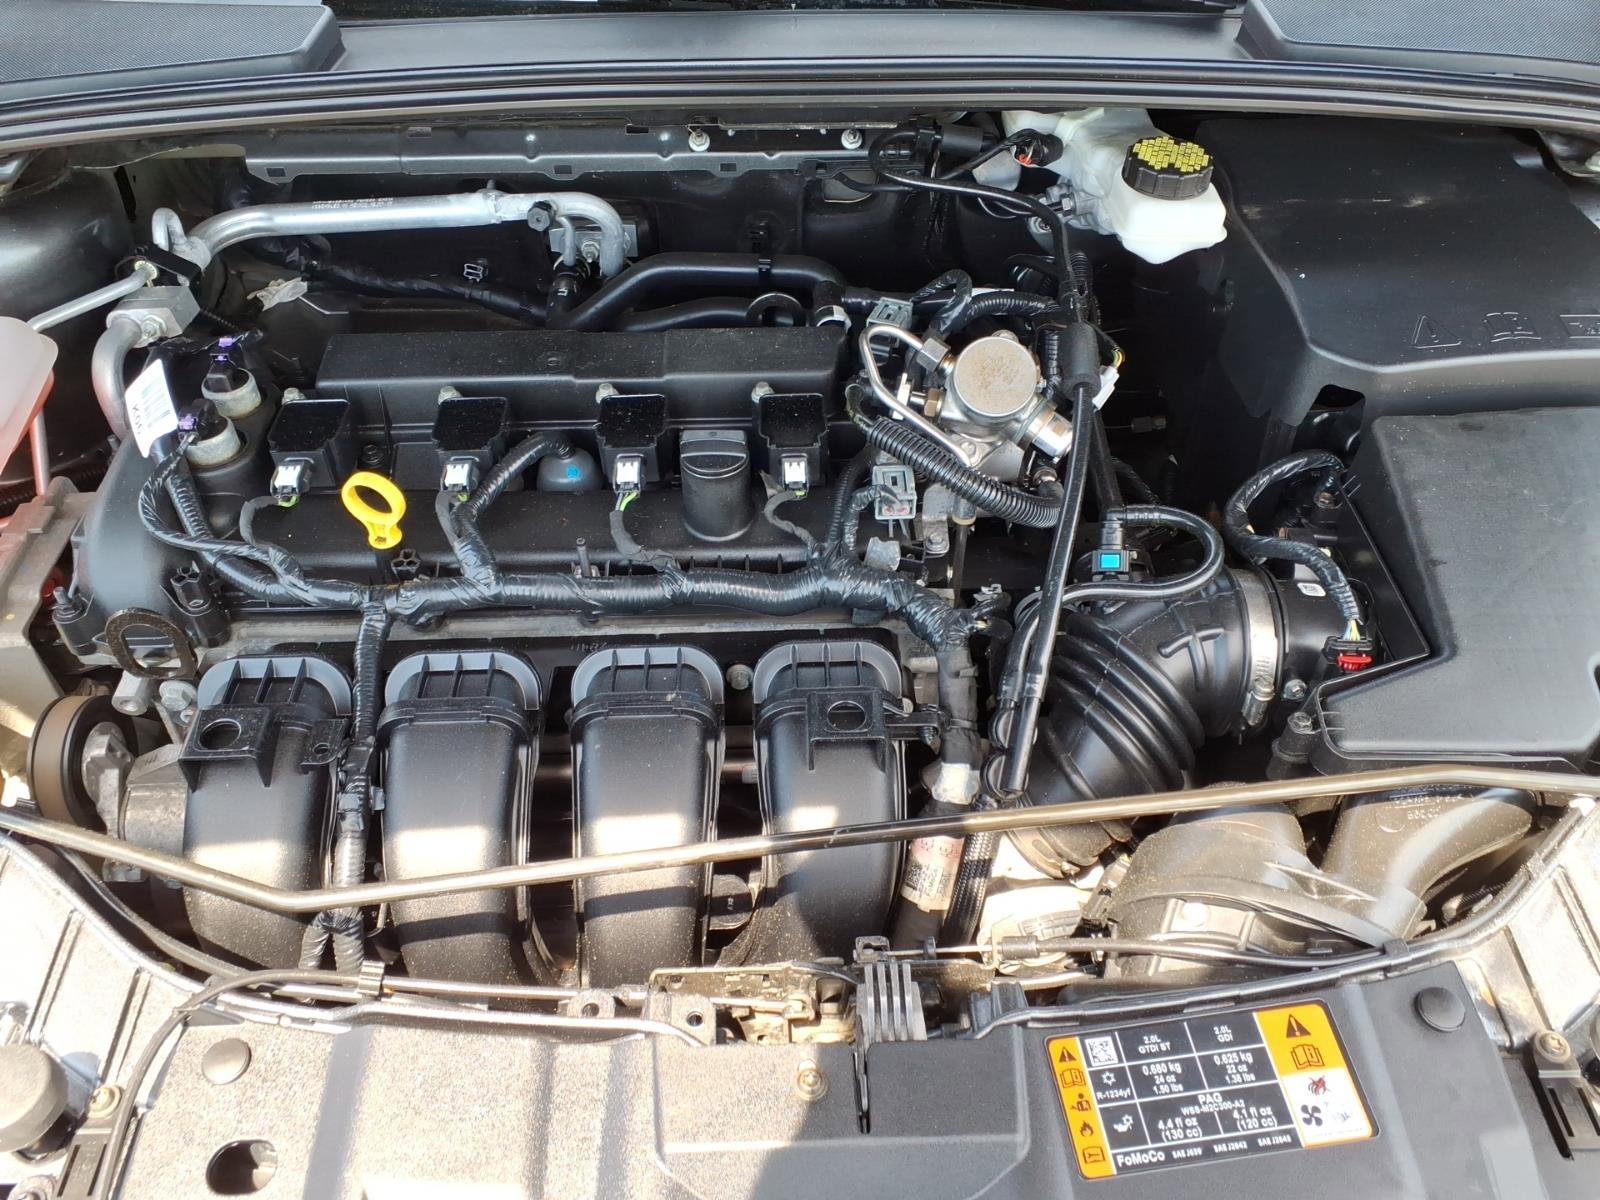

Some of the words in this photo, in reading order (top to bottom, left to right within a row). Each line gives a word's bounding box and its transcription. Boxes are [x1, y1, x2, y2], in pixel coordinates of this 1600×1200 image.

[1213, 1024, 1232, 1035] 2.0L
[1143, 1034, 1162, 1045] 2.0L
[1217, 1033, 1234, 1043] GDI
[1138, 1044, 1159, 1054] GTDI
[1160, 1041, 1171, 1051] ST
[1239, 1051, 1253, 1064] kg
[1142, 1063, 1167, 1076] 0.680
[1168, 1062, 1182, 1074] kg
[1226, 1064, 1237, 1074] 22
[1237, 1064, 1248, 1073] oz
[1154, 1075, 1165, 1084] 24
[1166, 1074, 1176, 1083] oz
[1242, 1072, 1256, 1082] lbs
[1096, 1087, 1131, 1100] R-1234yf
[1153, 1085, 1169, 1095] 1.50
[1170, 1083, 1184, 1093] lbs
[1197, 1092, 1222, 1105] PAG
[1233, 1109, 1248, 1120] 4.1
[1249, 1106, 1258, 1117] fl
[1259, 1106, 1273, 1116] oz
[1158, 1119, 1174, 1130] 4.4
[1174, 1117, 1183, 1128] fl
[1185, 1117, 1198, 1127] oz
[1236, 1119, 1259, 1133] (120
[1261, 1115, 1277, 1128] cc)
[1162, 1129, 1184, 1144] (130
[1186, 1126, 1203, 1138] cc)
[1116, 1150, 1165, 1167] FoMoCo
